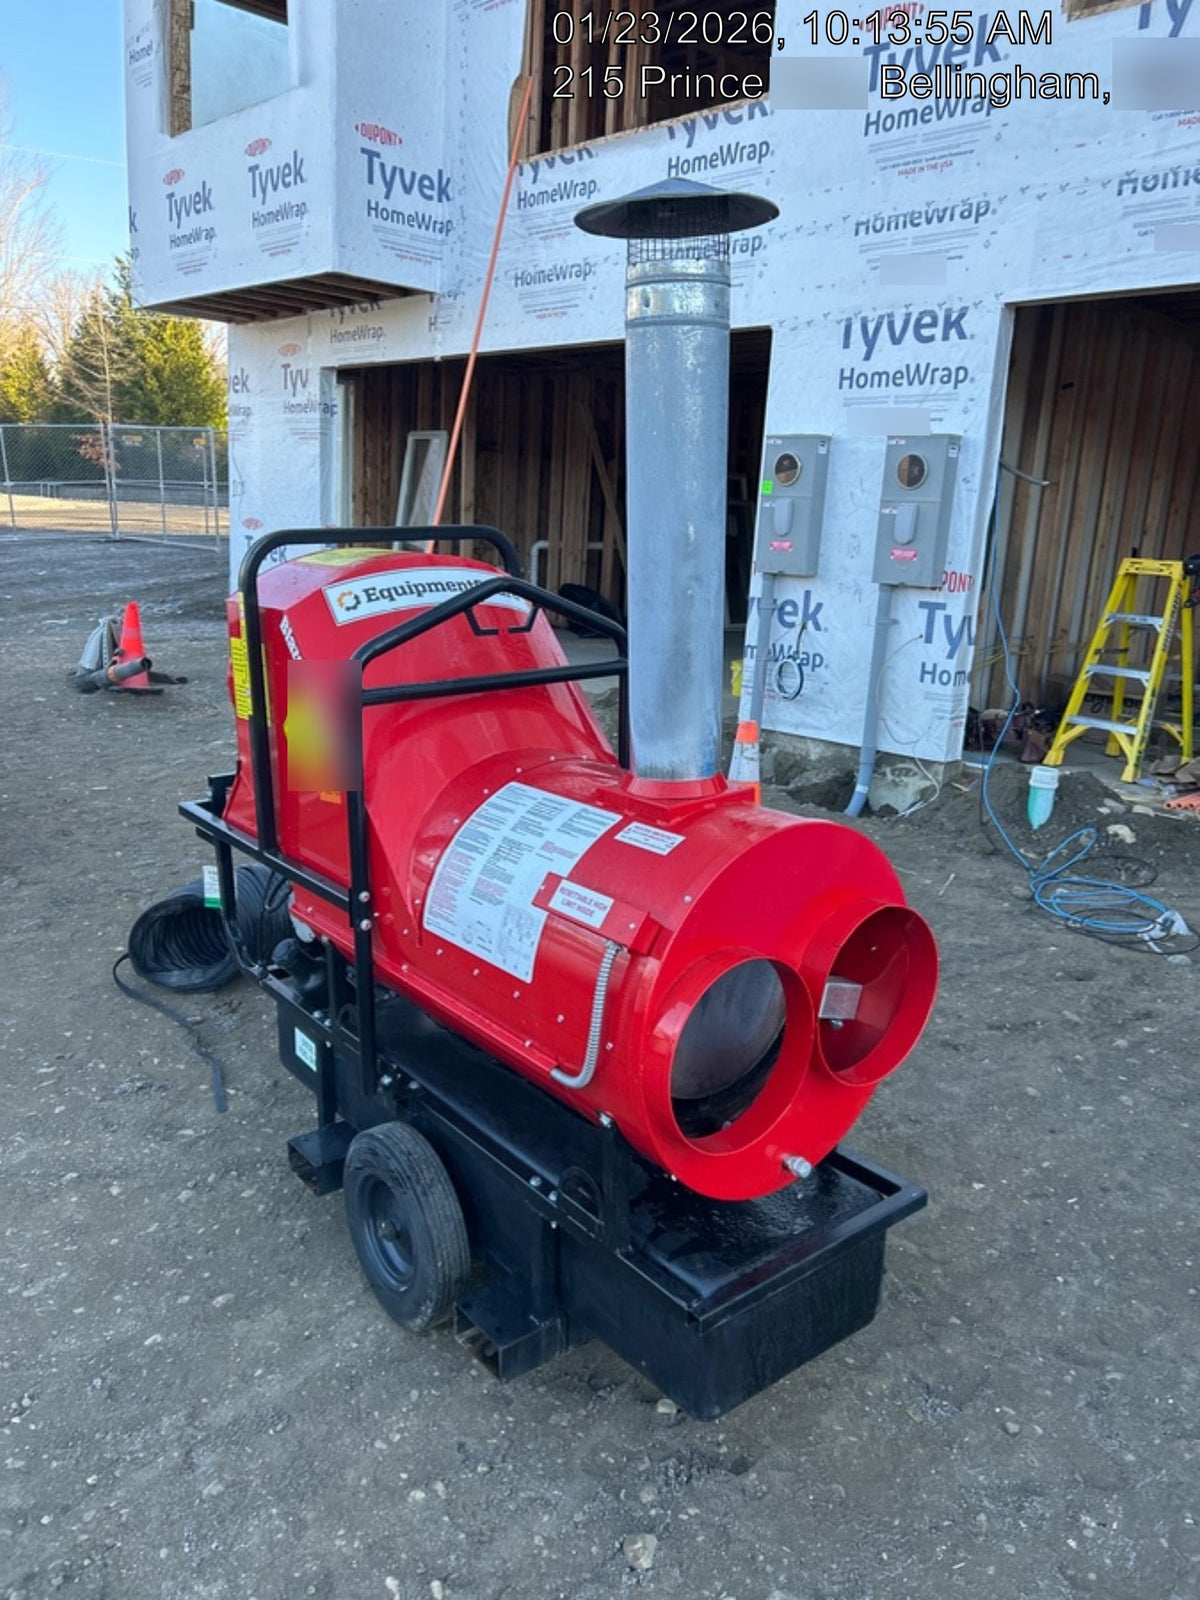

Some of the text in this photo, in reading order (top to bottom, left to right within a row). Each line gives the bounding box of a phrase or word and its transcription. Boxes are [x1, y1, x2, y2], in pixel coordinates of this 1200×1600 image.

[863, 14, 1002, 101] Tyvek
[864, 90, 998, 137] HomeWrap
[360, 147, 451, 204] Tyvek
[667, 140, 771, 178] HomeWrap
[248, 149, 305, 206] Tyvek
[517, 179, 598, 210] HomeWrap
[165, 180, 214, 229] Tyvek
[252, 201, 306, 229] HomeWrap
[367, 198, 457, 238] HomeWrap
[170, 226, 215, 250] HomeWrap
[514, 261, 594, 288] HomeWrap
[330, 324, 383, 344] HomeWrap
[838, 362, 968, 390] HomeWrap
[940, 570, 974, 592] PONT
